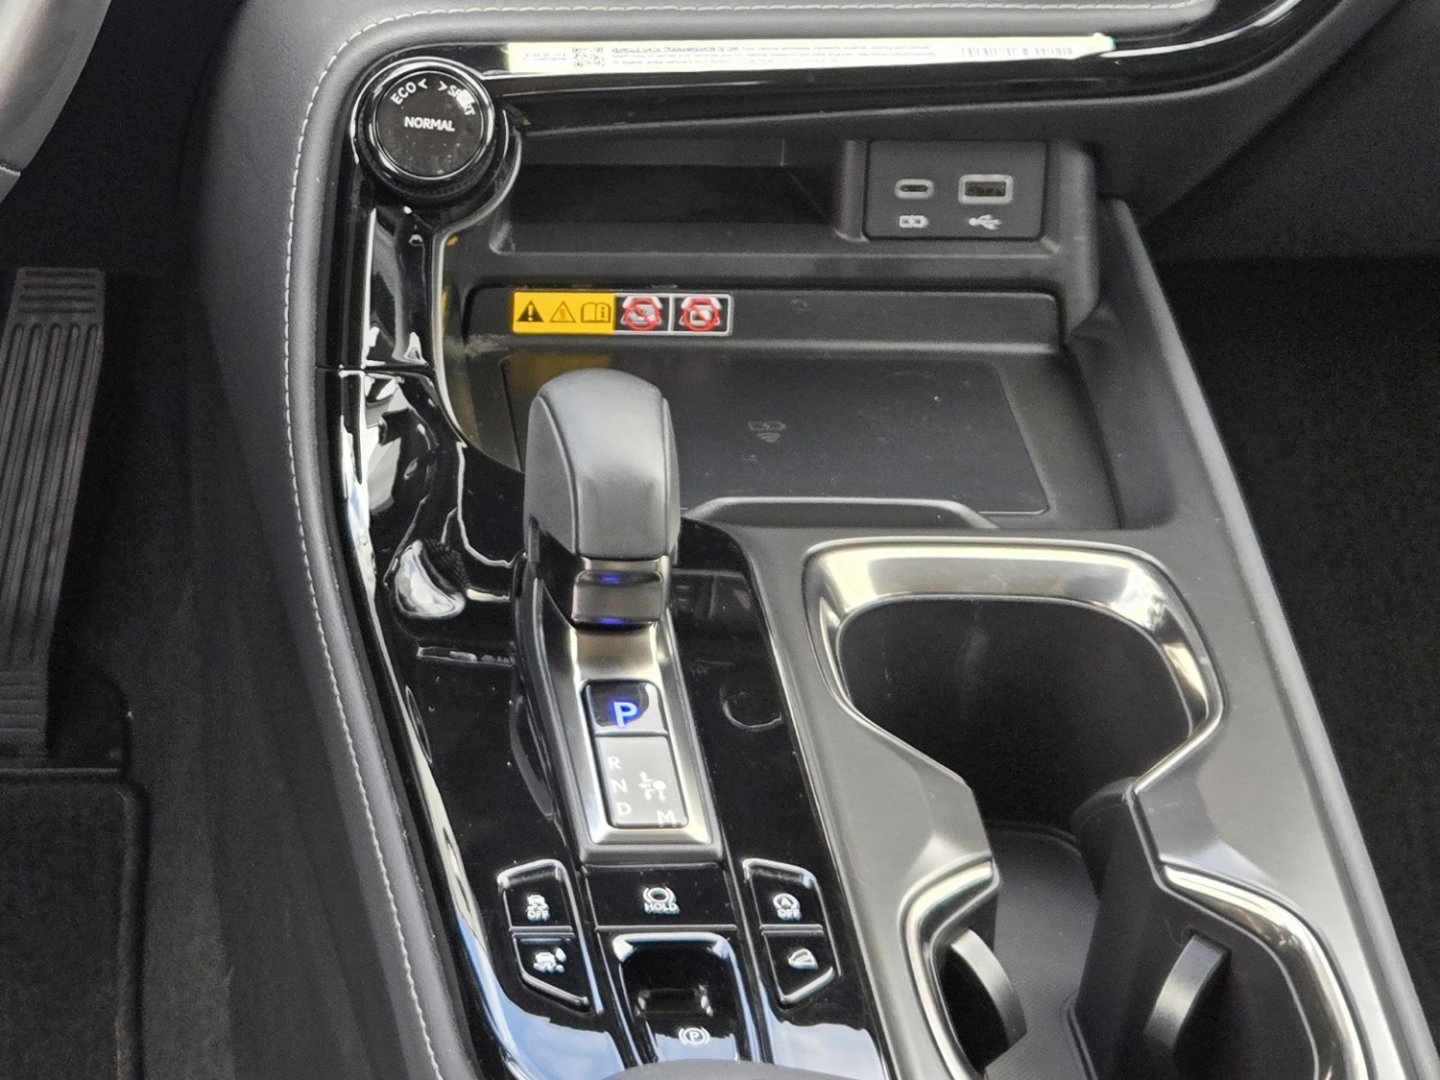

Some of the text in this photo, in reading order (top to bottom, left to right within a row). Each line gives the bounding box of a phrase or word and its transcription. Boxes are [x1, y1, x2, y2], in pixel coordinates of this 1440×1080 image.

[390, 82, 417, 105] ECO
[404, 116, 456, 132] NORMAL
[613, 702, 638, 728] P
[607, 756, 621, 770] R
[611, 779, 627, 793] N
[616, 802, 632, 816] D
[656, 810, 676, 827] M
[527, 909, 549, 921] OFF
[644, 902, 679, 914] HOLD
[777, 909, 801, 920] OFF
